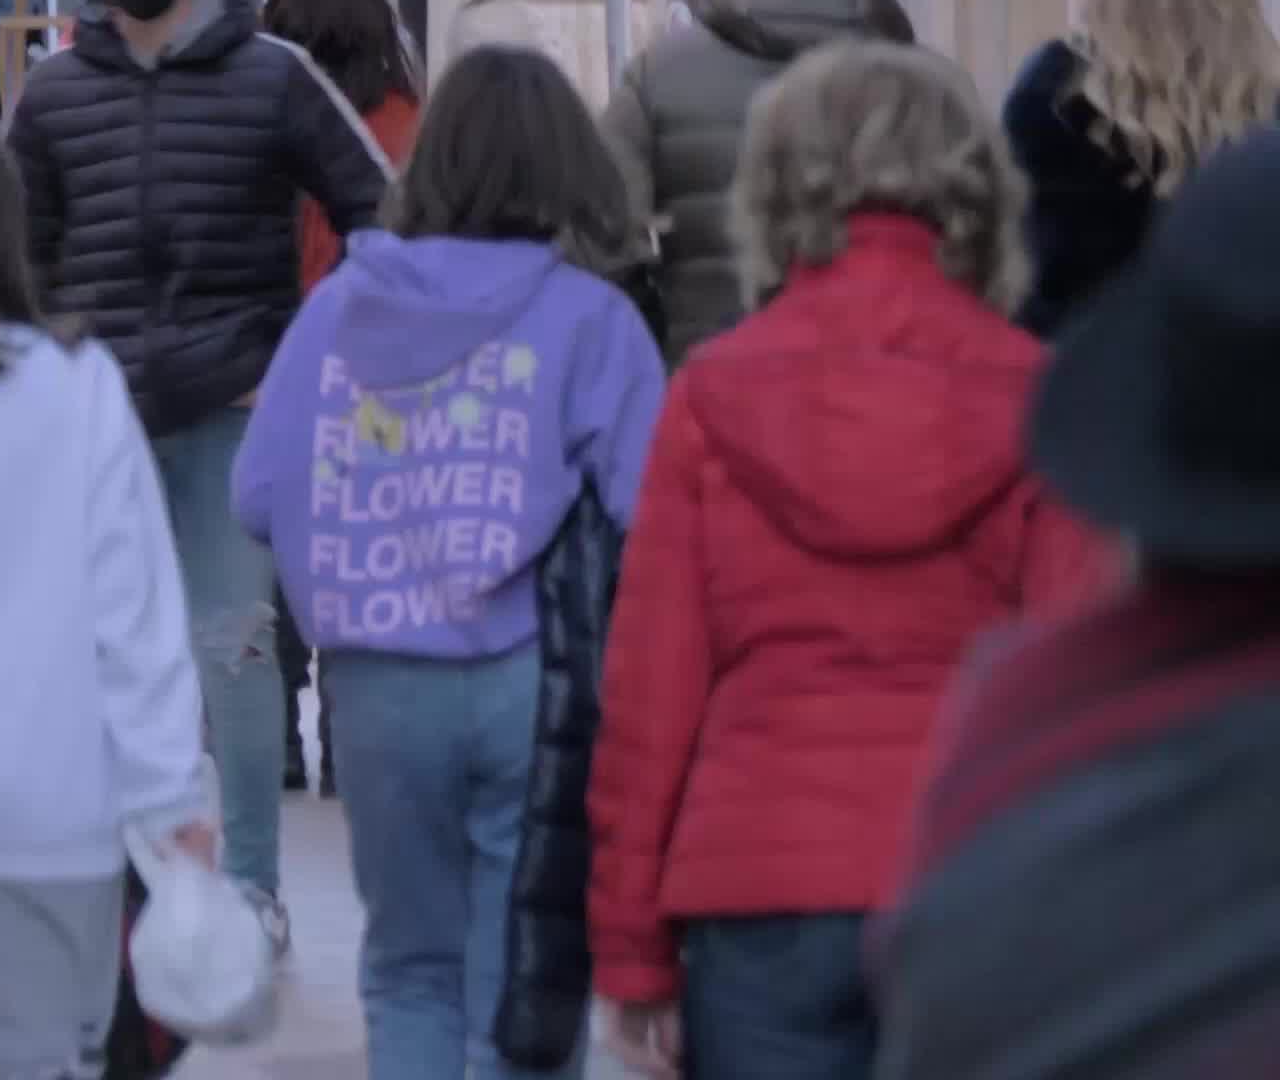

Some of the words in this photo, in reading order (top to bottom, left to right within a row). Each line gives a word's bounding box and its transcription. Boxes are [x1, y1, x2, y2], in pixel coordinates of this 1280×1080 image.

[313, 408, 530, 466] FLWER
[311, 461, 523, 522] FLOWER
[309, 517, 519, 582] FLOWER
